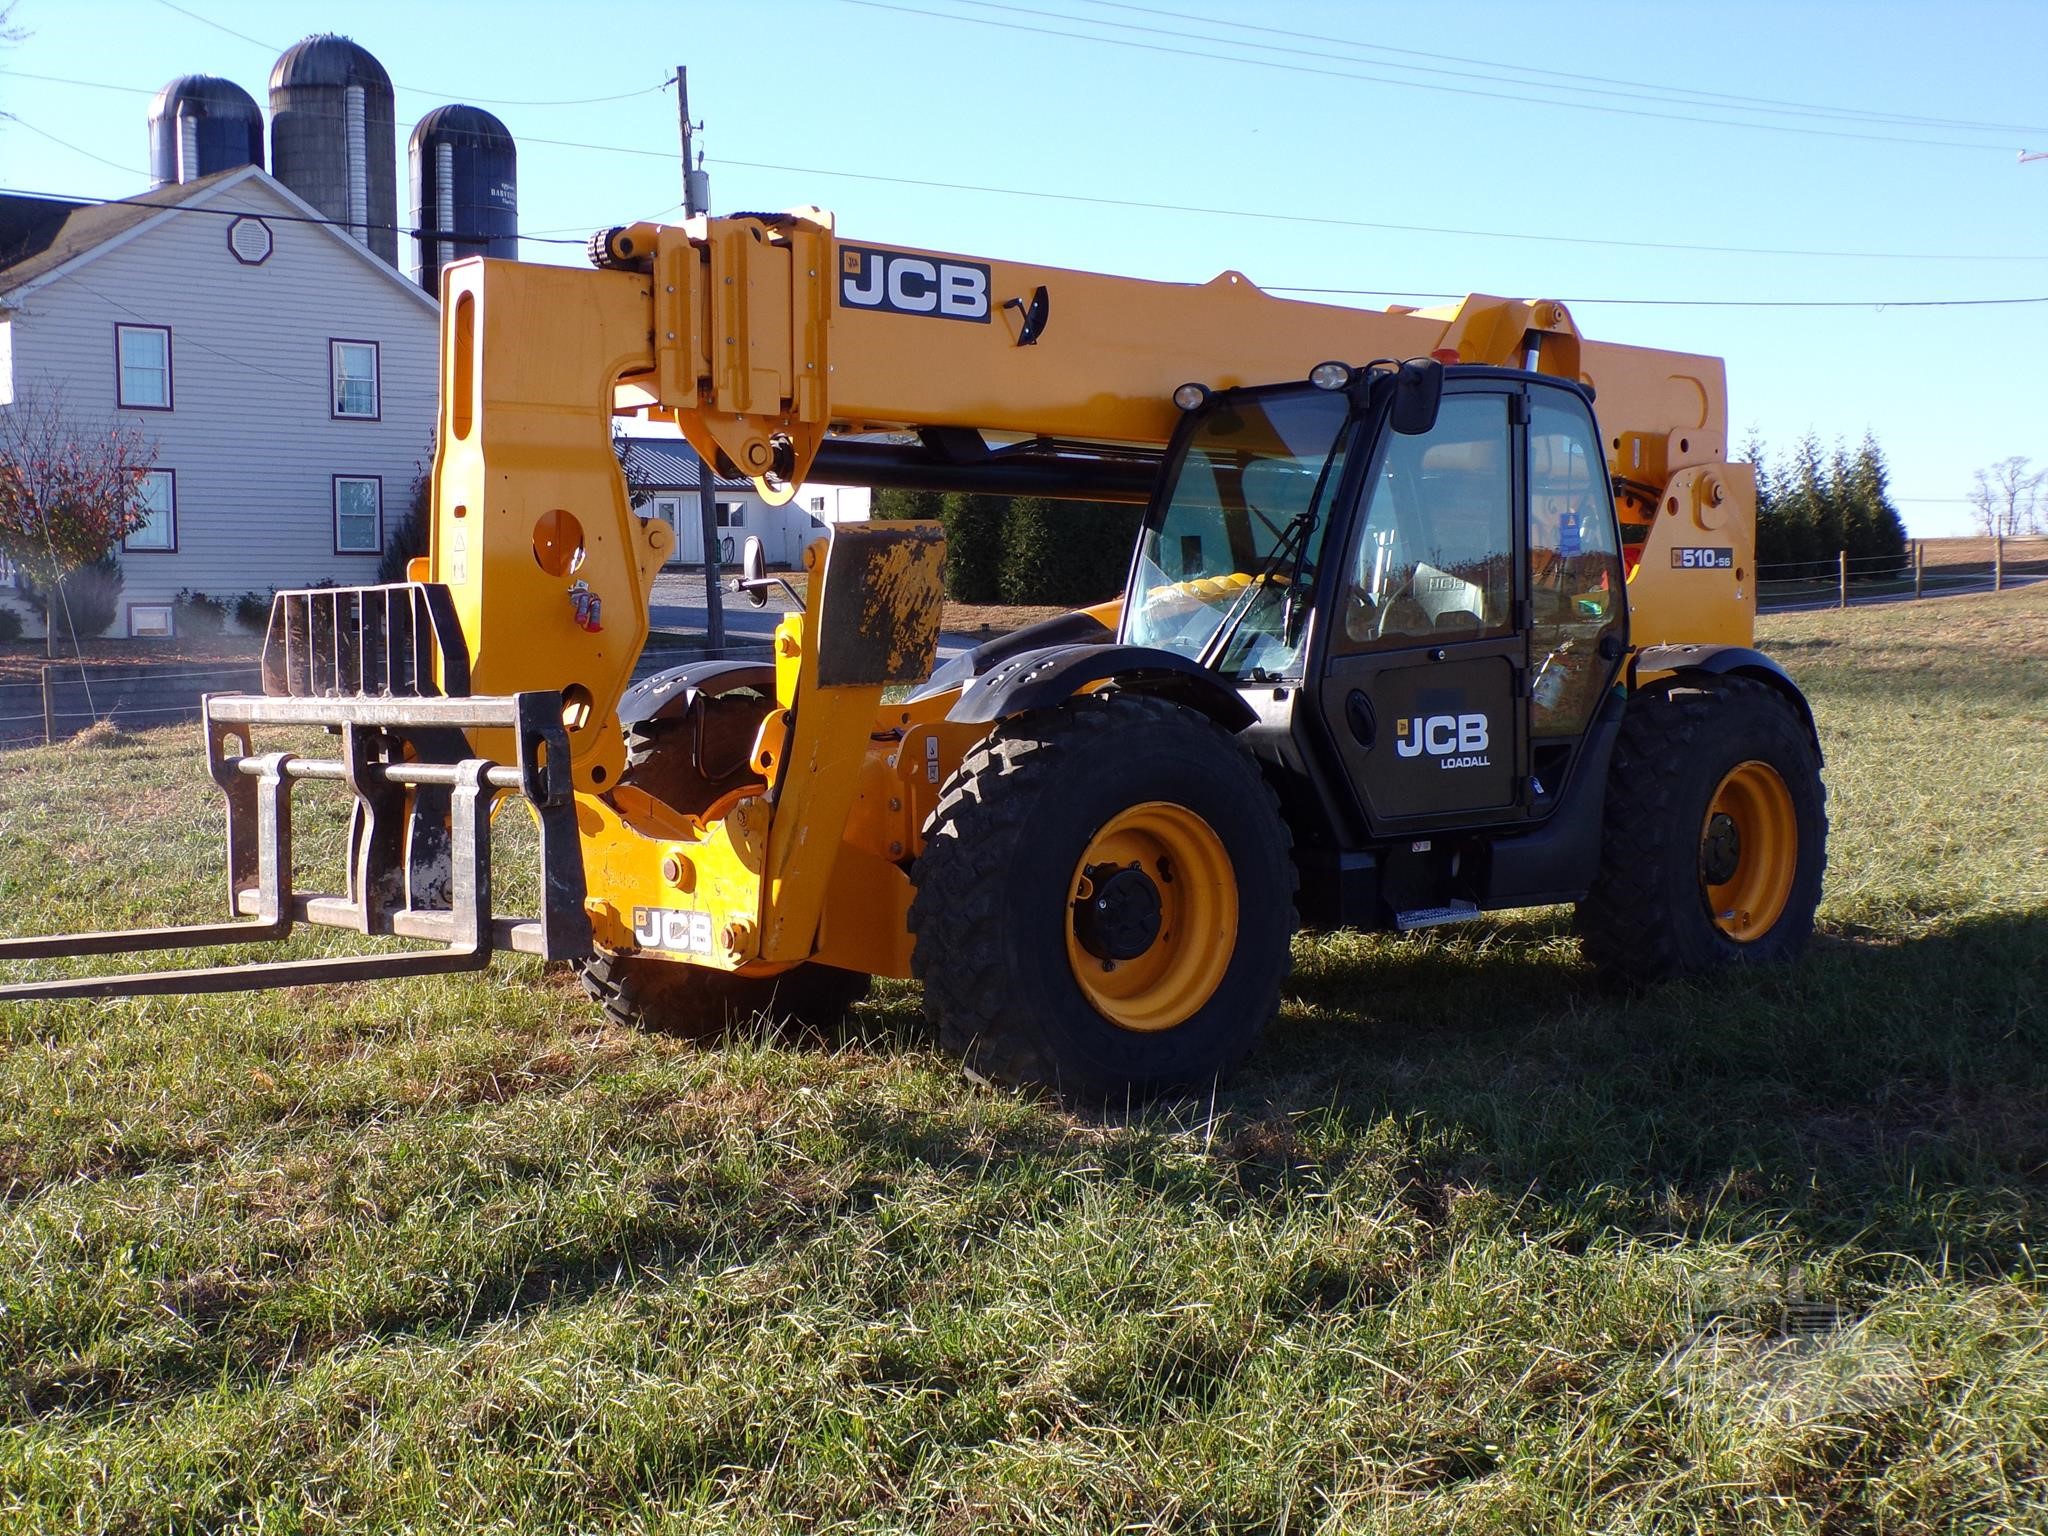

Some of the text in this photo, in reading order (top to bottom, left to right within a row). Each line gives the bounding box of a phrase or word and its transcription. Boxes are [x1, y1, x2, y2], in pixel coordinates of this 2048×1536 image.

[844, 254, 988, 318] JCB
[1397, 713, 1489, 758] JCB
[1441, 756, 1491, 770] LOADALL
[635, 911, 712, 953] JCB
